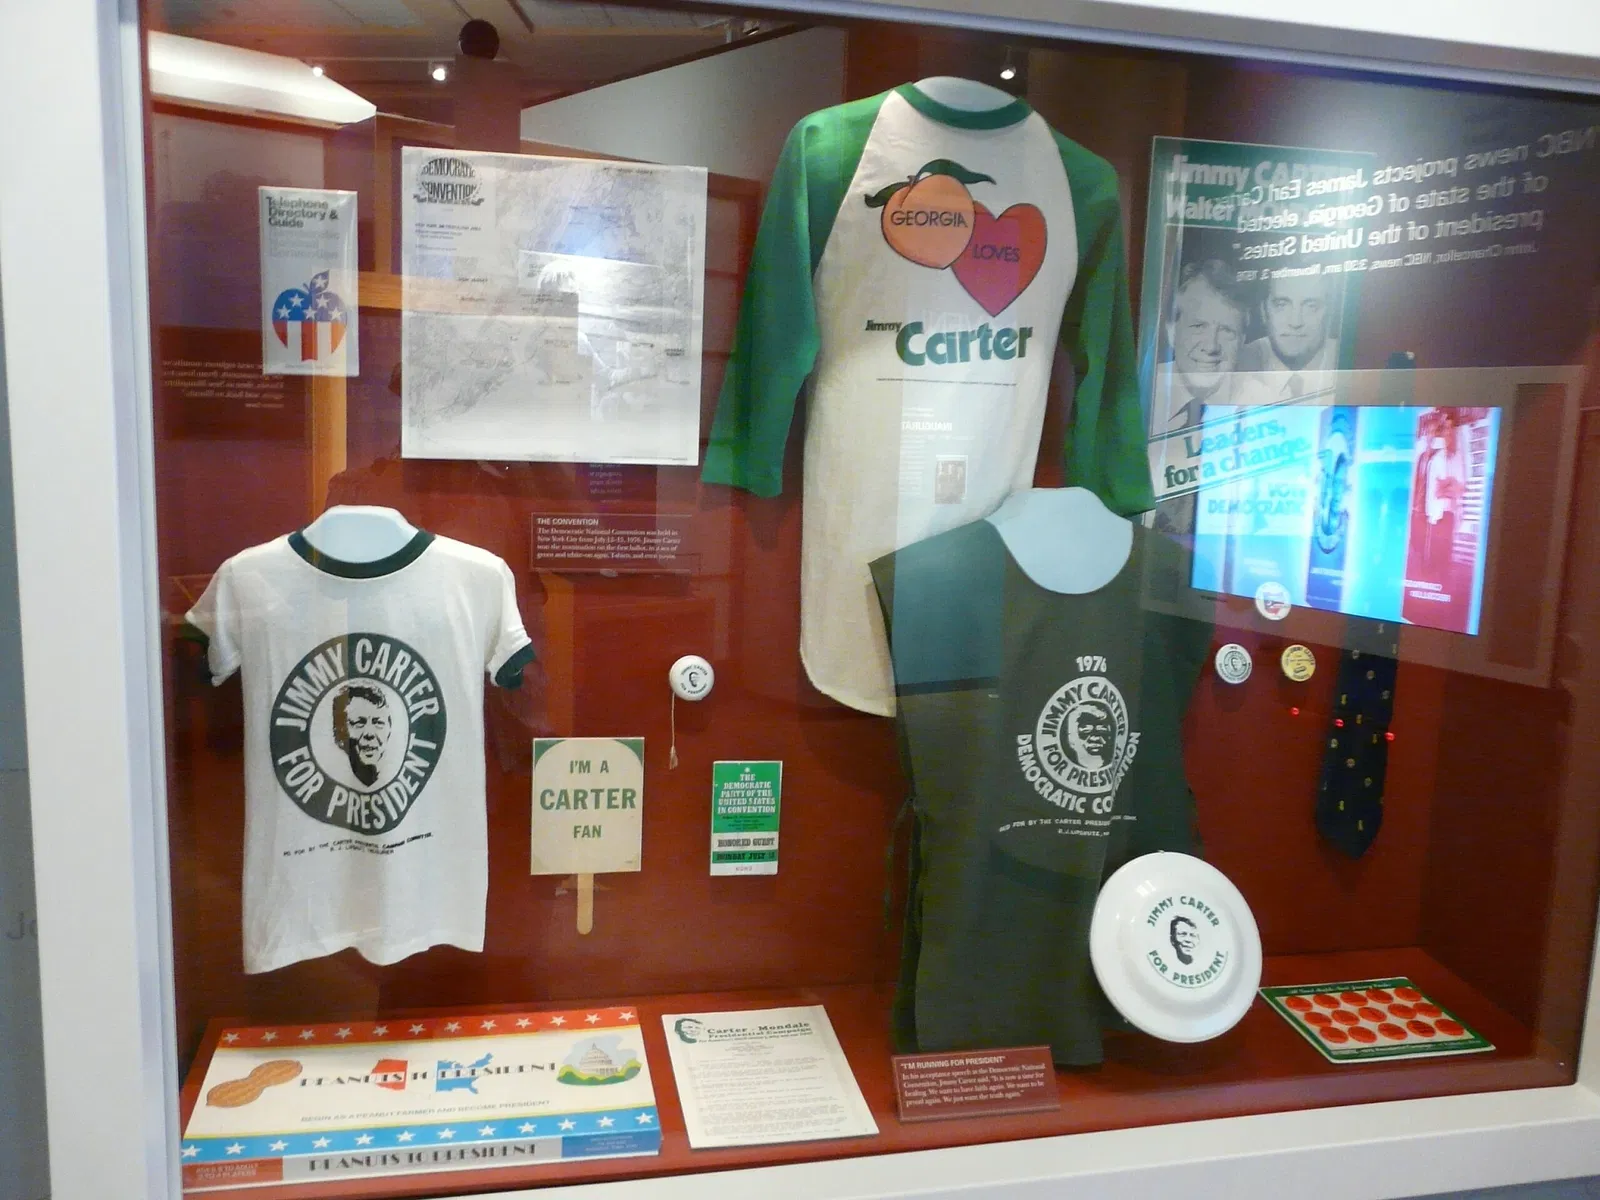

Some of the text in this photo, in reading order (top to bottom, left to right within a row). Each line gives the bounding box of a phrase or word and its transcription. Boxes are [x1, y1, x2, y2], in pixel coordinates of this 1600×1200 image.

[420, 157, 475, 178] DEMOCRATIC
[1167, 154, 1250, 192] Jimmy
[421, 181, 478, 202] CONVENTION
[265, 196, 328, 209] Telephone
[1166, 194, 1235, 221] Walter
[268, 207, 339, 221] Directory &
[268, 217, 304, 228] Guide
[890, 210, 969, 228] GEORGIA
[972, 243, 1021, 262] LOVES
[865, 319, 1033, 366] Jimmy Carter
[1184, 419, 1286, 459] Leaders,
[1164, 464, 1199, 488] for
[1202, 461, 1216, 478] a
[552, 518, 599, 526] CONVENTION
[594, 536, 605, 544] July
[1075, 655, 1107, 673] 1976
[275, 637, 440, 732] JIMMY CARTER
[1041, 682, 1126, 738] JIMMY CARTER
[569, 760, 610, 774] I'M A
[1043, 743, 1068, 775] FOR
[277, 732, 438, 829] FOR PRESIDENT
[740, 773, 756, 781] THE
[1016, 733, 1087, 814] DEMOCRATIC
[721, 789, 773, 798] PARTY OF THE
[723, 781, 771, 790] DEMOCRATIC
[540, 788, 637, 810] CARTER
[718, 797, 776, 806] UNITED STATES
[717, 805, 776, 814] IN CONVENTION
[573, 824, 602, 838] FAN
[717, 837, 776, 848] HONORED GUEST
[748, 852, 765, 860] JULY
[1147, 895, 1220, 927] JIMMY CARTER
[1148, 949, 1225, 985] FOR PRESIDENT
[708, 1031, 764, 1039] Presidential
[757, 1022, 810, 1031] Mondale
[916, 1060, 950, 1069] RUNNING
[919, 1071, 951, 1080] acceptance
[951, 1068, 971, 1078] speech
[1021, 1062, 1046, 1070] National
[300, 1062, 556, 1087] PEANUTS PRESIDENT
[939, 1079, 958, 1087] Jimmy
[974, 1084, 988, 1092] faith
[436, 1106, 457, 1114] AND
[499, 1100, 551, 1109] PRESIDENT
[906, 1098, 924, 1108] proud
[953, 1095, 964, 1104] just
[989, 1091, 1004, 1099] truth
[309, 1151, 401, 1171] PEANUTS
[431, 1143, 537, 1162] PRESIDENT
